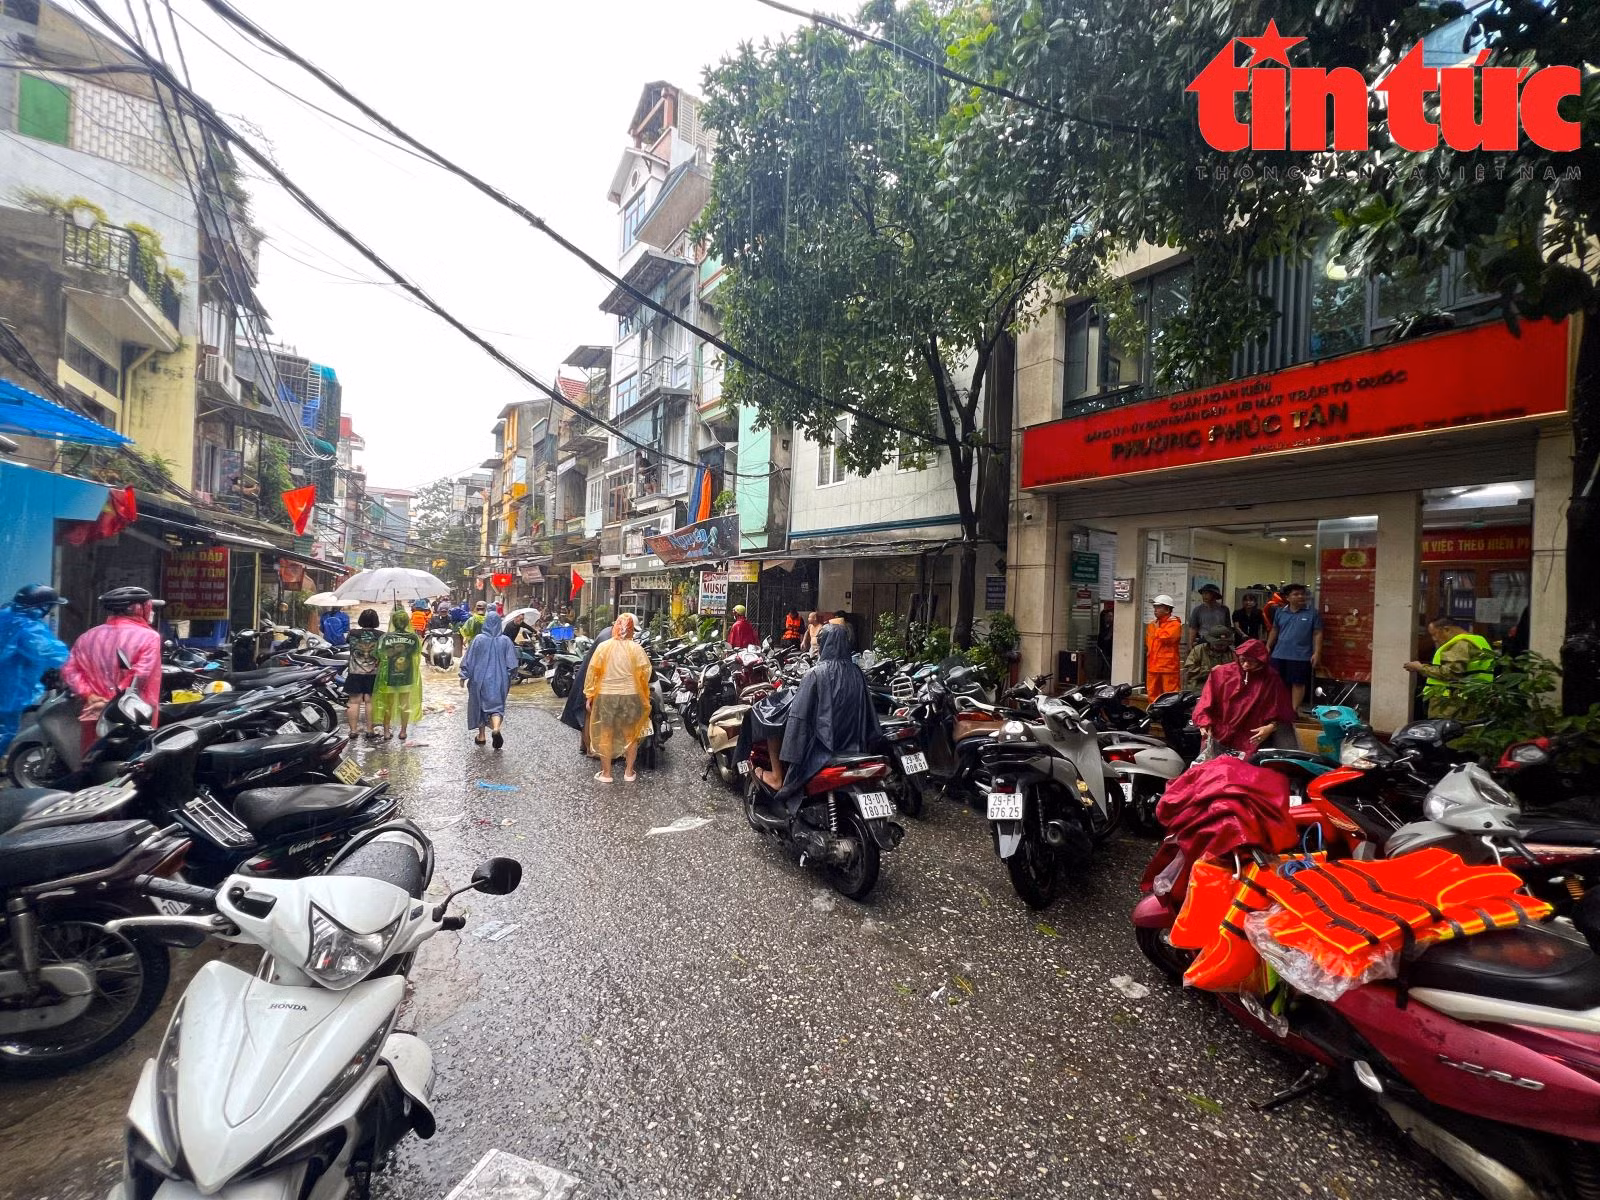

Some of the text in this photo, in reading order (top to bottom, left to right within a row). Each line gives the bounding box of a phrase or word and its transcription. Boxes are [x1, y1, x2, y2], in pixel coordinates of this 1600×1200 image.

[1208, 413, 1282, 443] PHÚC
[1290, 402, 1349, 430] TÂN
[703, 582, 727, 595] MUSIC
[268, 1003, 308, 1011] HONDA
